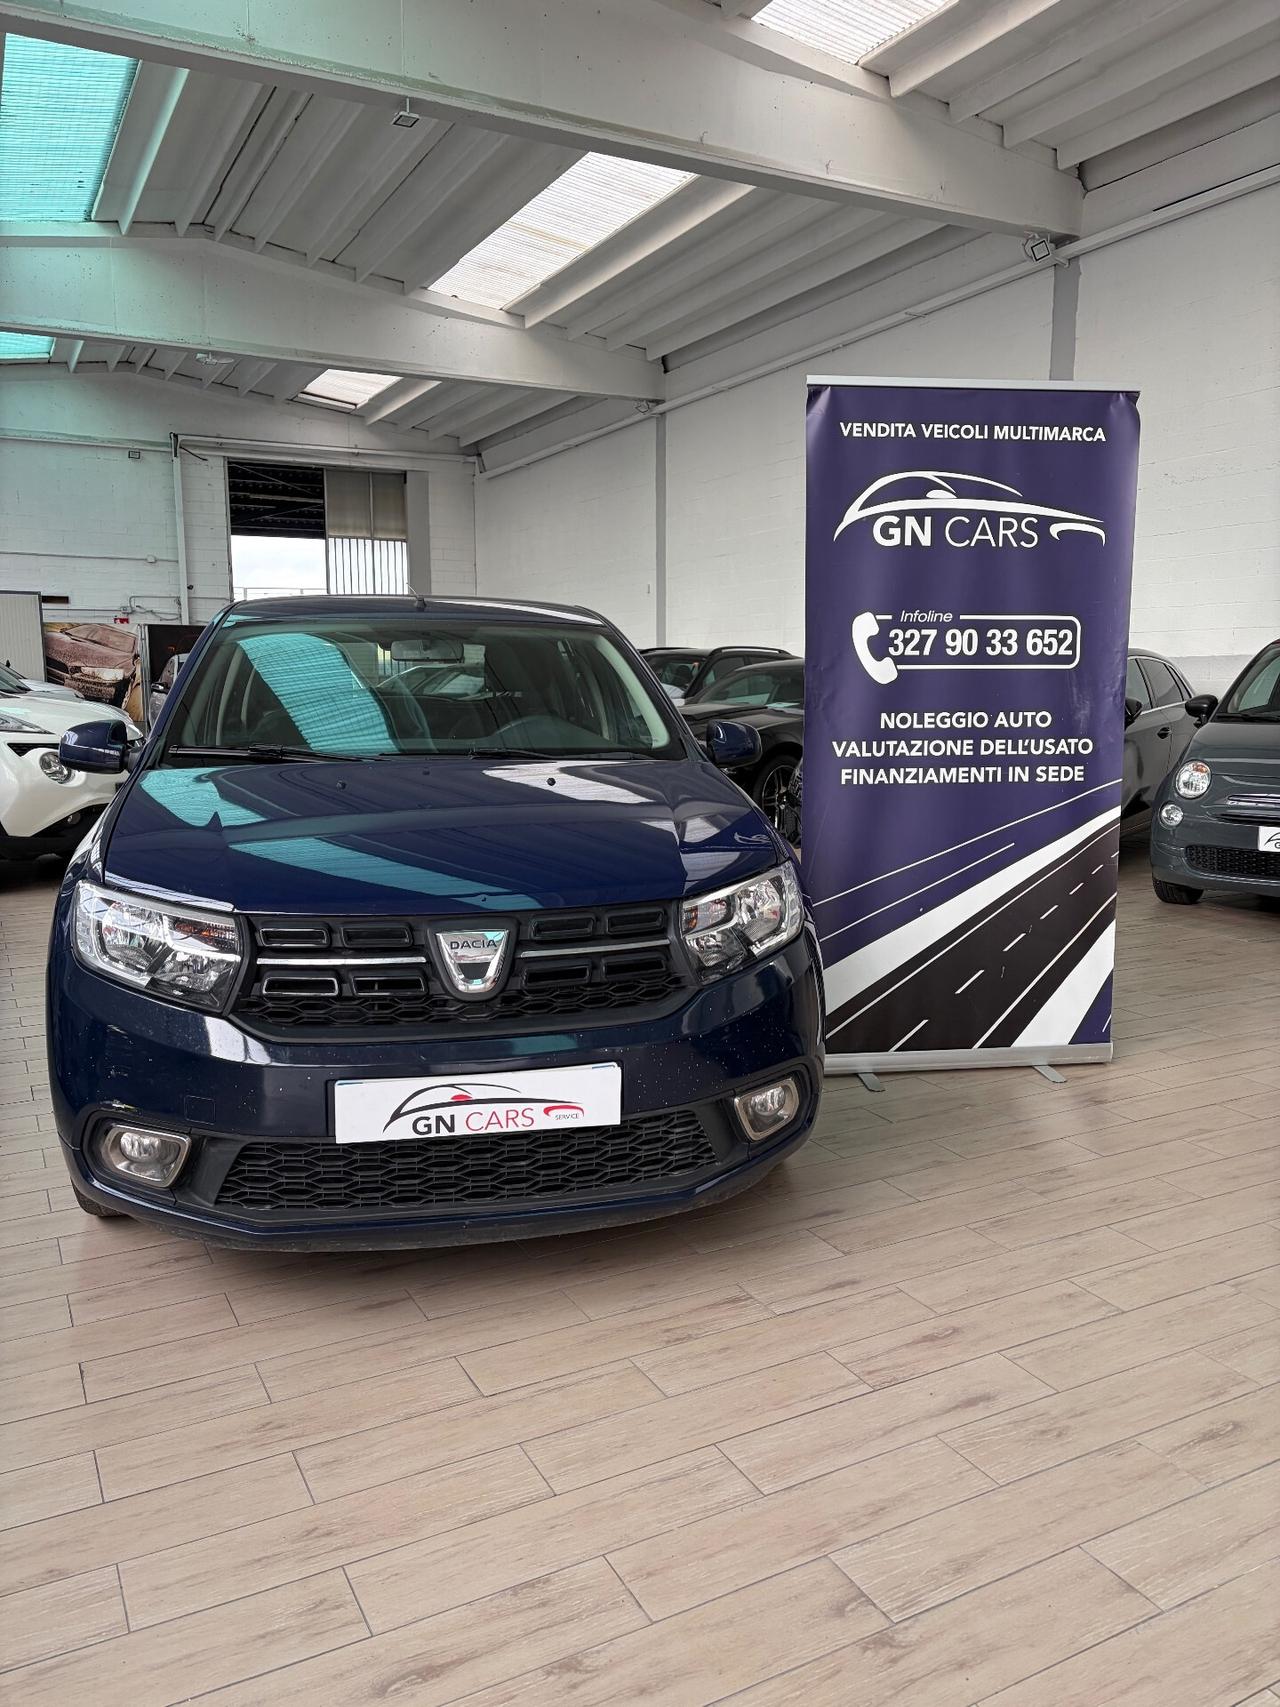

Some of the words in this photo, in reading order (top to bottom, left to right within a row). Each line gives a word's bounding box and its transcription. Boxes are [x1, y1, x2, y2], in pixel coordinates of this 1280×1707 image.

[839, 421, 917, 438] VENDITA
[920, 423, 989, 440] VEICOLI
[993, 425, 1107, 442] MULTIMARCA
[872, 515, 932, 547] GN
[944, 516, 1039, 548] CARS
[900, 609, 954, 623] Infoline
[888, 628, 938, 656] 327
[945, 628, 979, 656] 90
[985, 628, 1019, 656] 33
[1026, 628, 1074, 656] 652
[880, 711, 989, 729] NOLEGGIO
[994, 711, 1053, 728] AUTO
[831, 739, 974, 758] VALUTAZIONE
[841, 766, 1002, 785] FINANZIAMENTI
[1008, 766, 1030, 783] IN
[1035, 765, 1085, 783] SEDE
[450, 939, 498, 950] DACIA
[412, 1113, 455, 1136] GN
[465, 1108, 535, 1132] CARS
